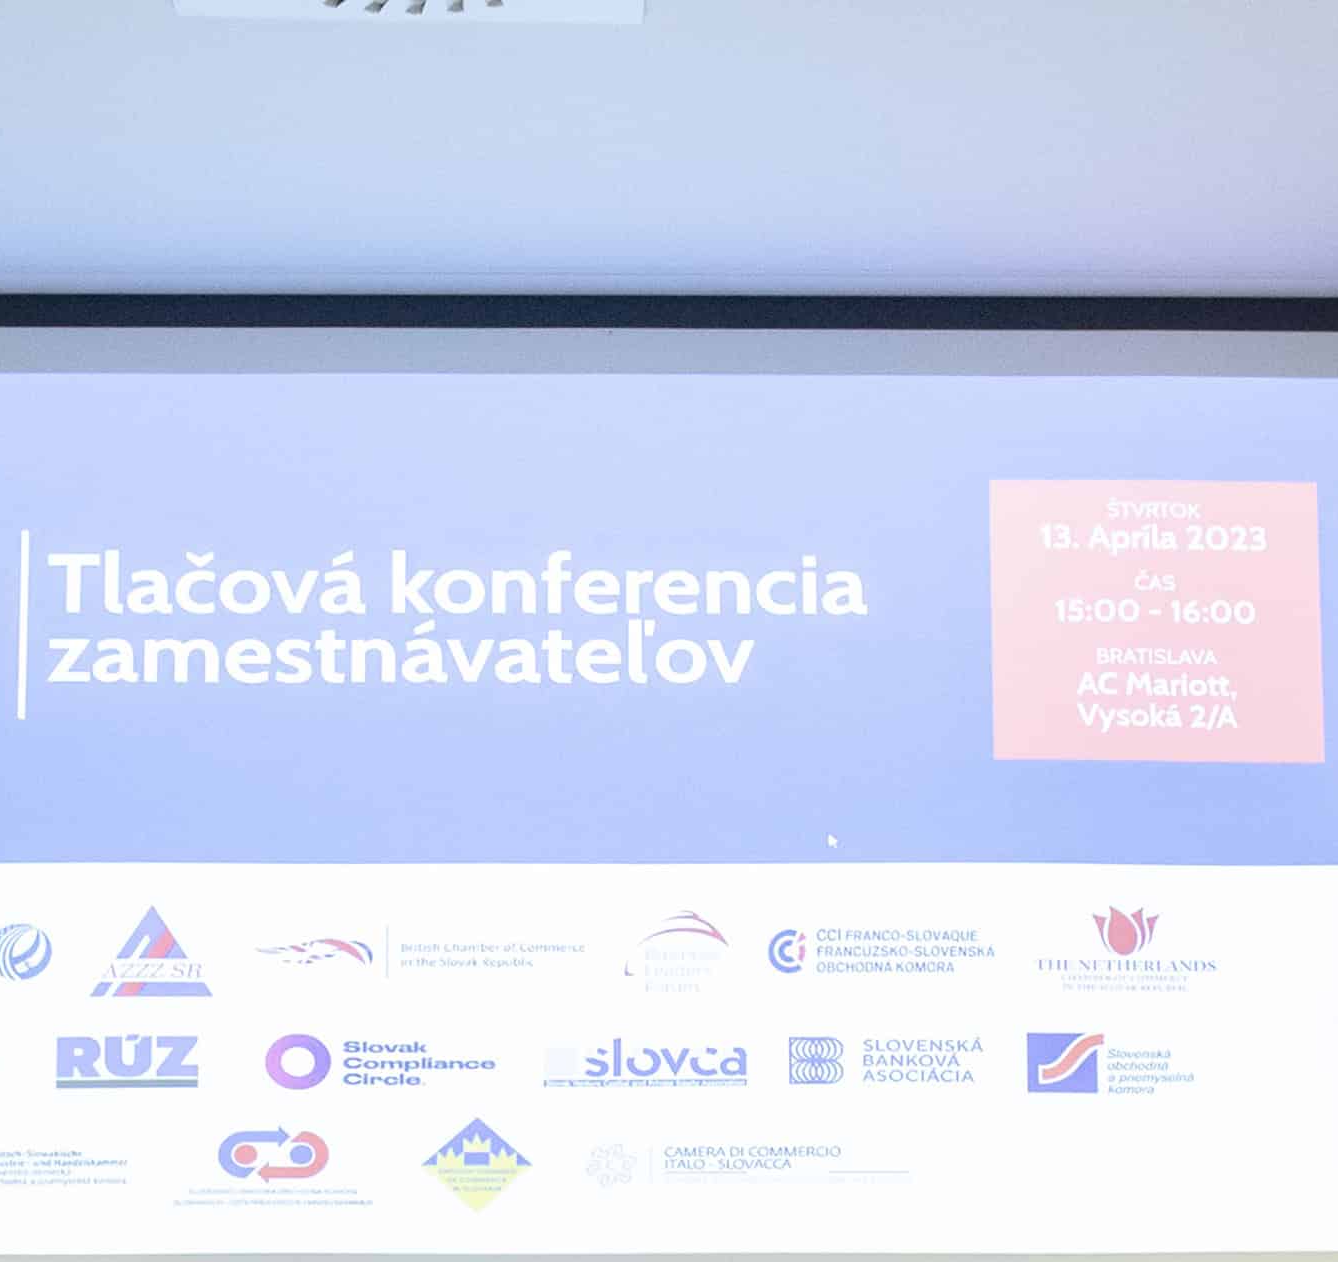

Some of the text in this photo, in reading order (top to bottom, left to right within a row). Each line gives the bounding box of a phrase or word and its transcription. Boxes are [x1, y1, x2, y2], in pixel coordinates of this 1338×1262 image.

[1107, 497, 1202, 519] ŠTVRTOK
[1040, 523, 1079, 550] 13.
[1186, 525, 1268, 552] 2023
[47, 549, 868, 615] Tlačová konferencia
[1133, 569, 1176, 592] ČAS
[1054, 599, 1141, 624] 15:00
[1170, 599, 1256, 625] 16:00
[47, 619, 755, 684] zamestnávateľov
[1096, 648, 1218, 665] BRATISLAVA
[1077, 672, 1118, 696] AC
[1077, 703, 1238, 733] Vysoká 2/A
[56, 1033, 198, 1078] RÚZ
[343, 1041, 427, 1054] Slovak
[343, 1057, 496, 1072] Compliance
[664, 1146, 842, 1158] CAMERA DI COMMERCIO
[664, 1158, 706, 1170] ITALO
[717, 1158, 793, 1170] SLOVACCA
